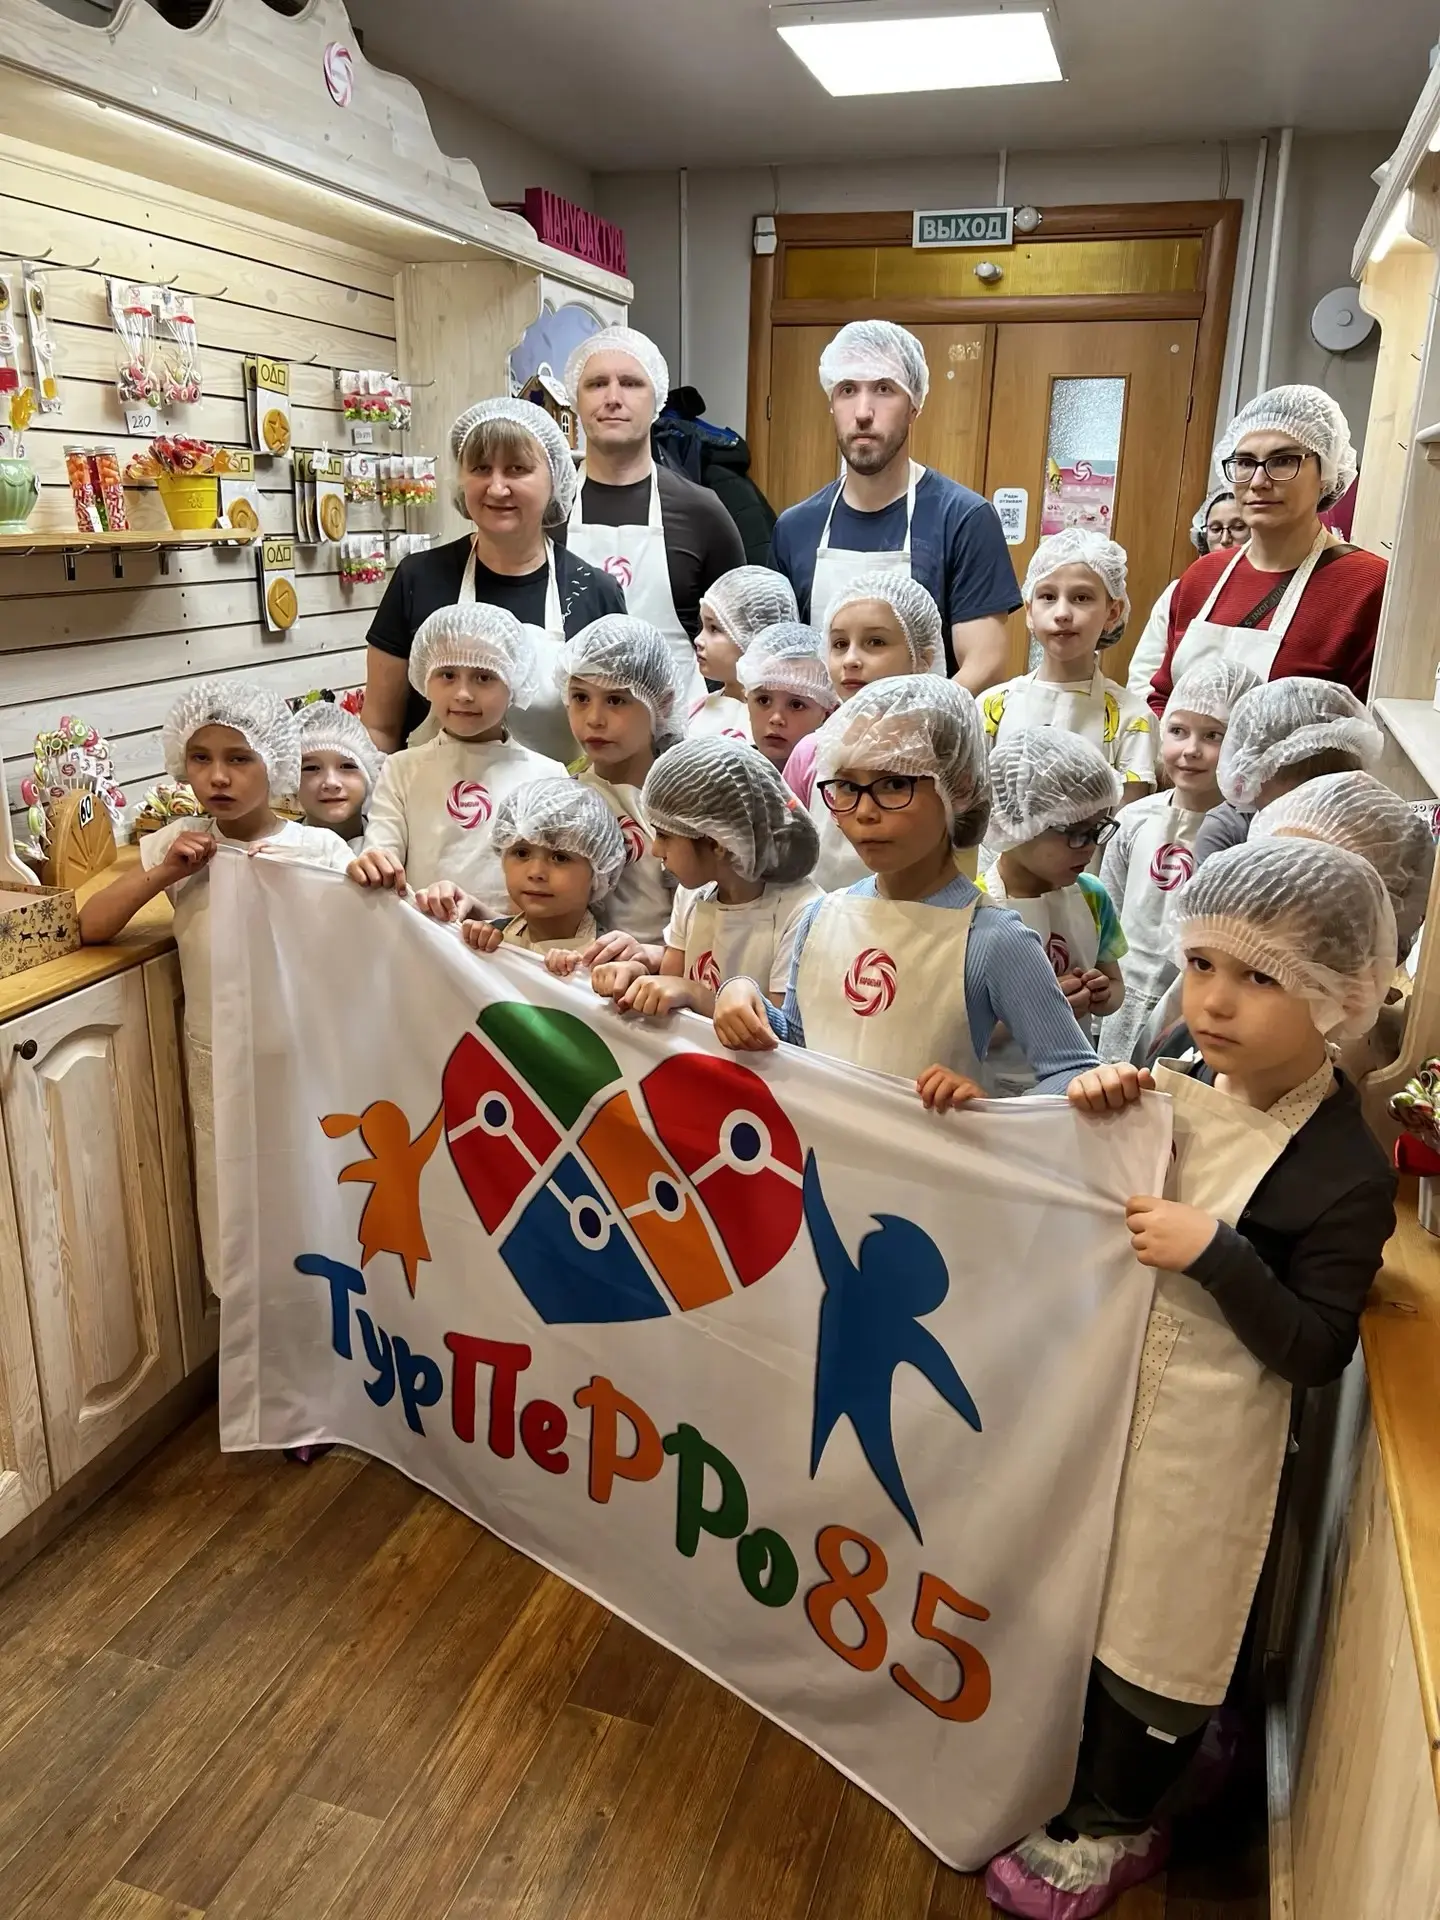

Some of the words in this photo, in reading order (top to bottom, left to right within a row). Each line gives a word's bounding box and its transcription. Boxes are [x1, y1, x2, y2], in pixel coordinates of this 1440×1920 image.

[542, 189, 628, 275] МАНУФАКТУРА
[922, 216, 1003, 240] ВЫХОД
[131, 415, 152, 429] 280
[80, 795, 92, 824] 60
